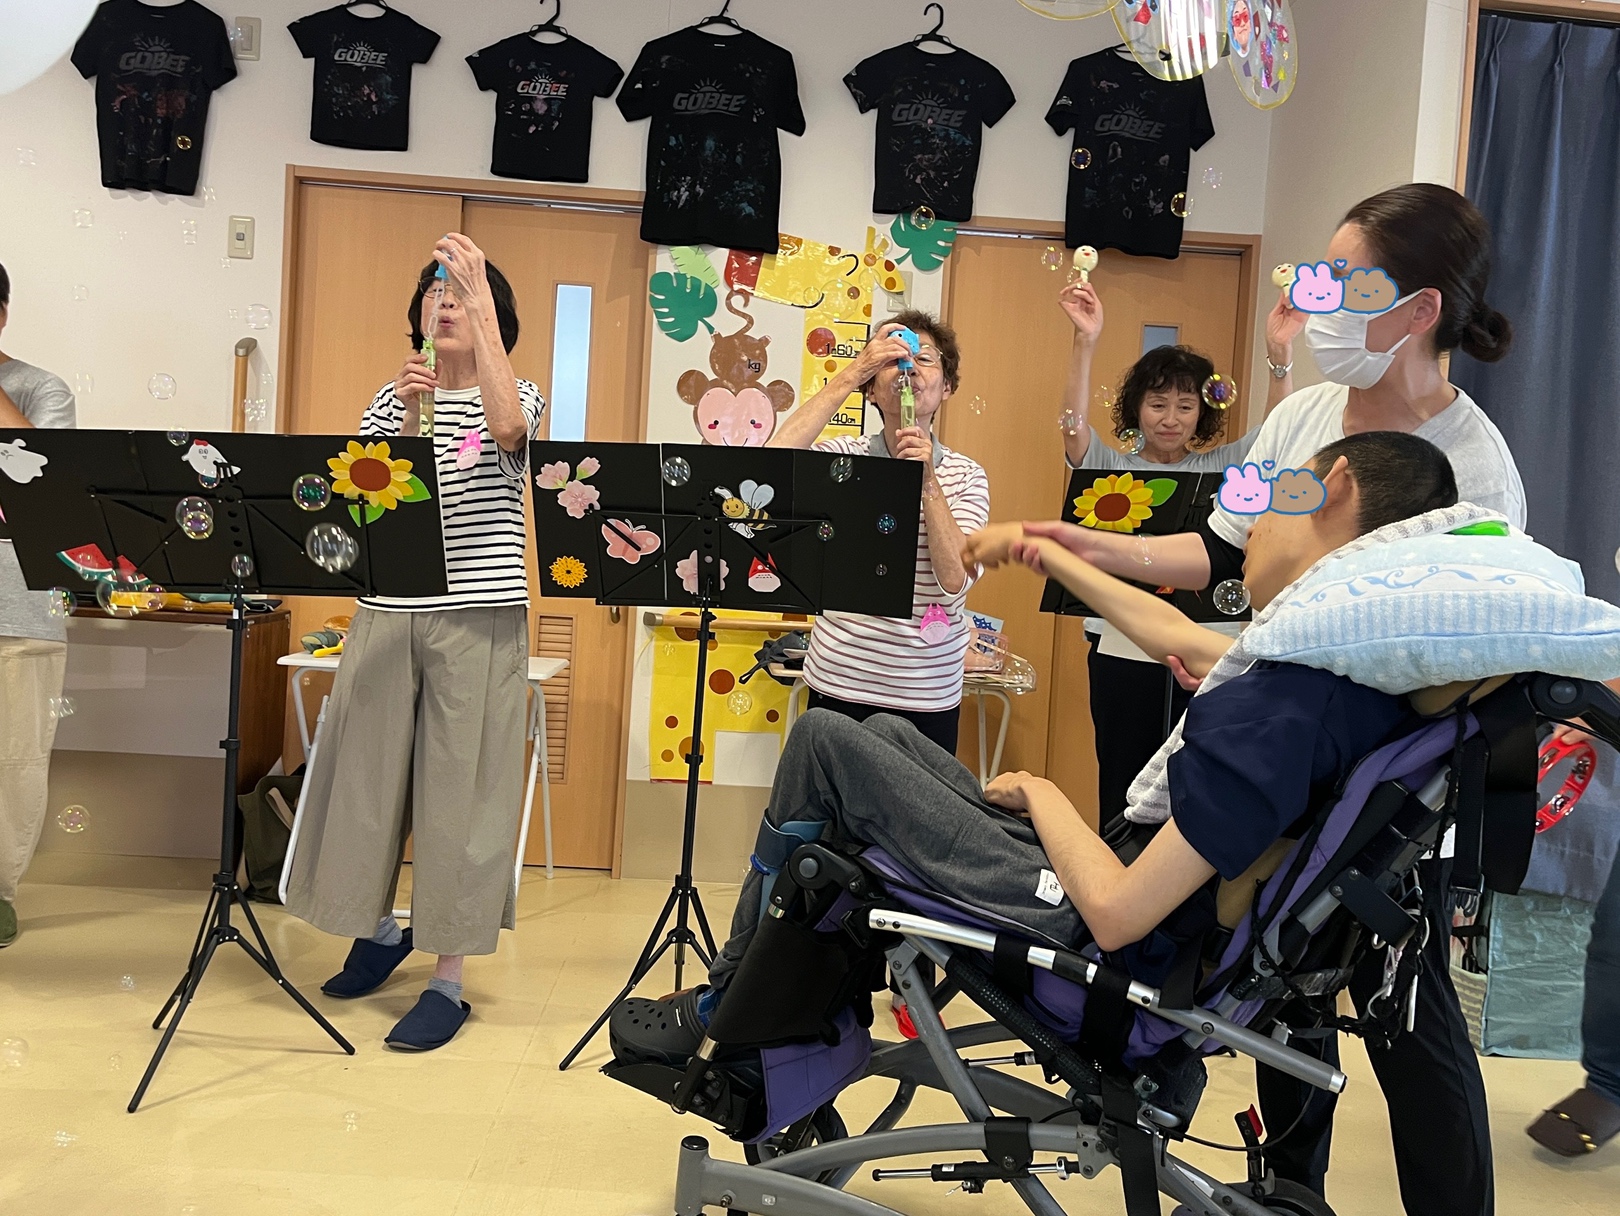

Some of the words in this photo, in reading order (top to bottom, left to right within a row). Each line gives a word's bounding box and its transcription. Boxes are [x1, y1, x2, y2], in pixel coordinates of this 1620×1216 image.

[119, 51, 191, 72] GOBEE
[334, 48, 388, 64] GOBEE
[517, 81, 569, 95] GOBEE
[673, 93, 745, 111] GOBEE
[892, 104, 967, 127] GOBEE
[1094, 114, 1166, 138] GOBEE
[747, 359, 761, 373] kg
